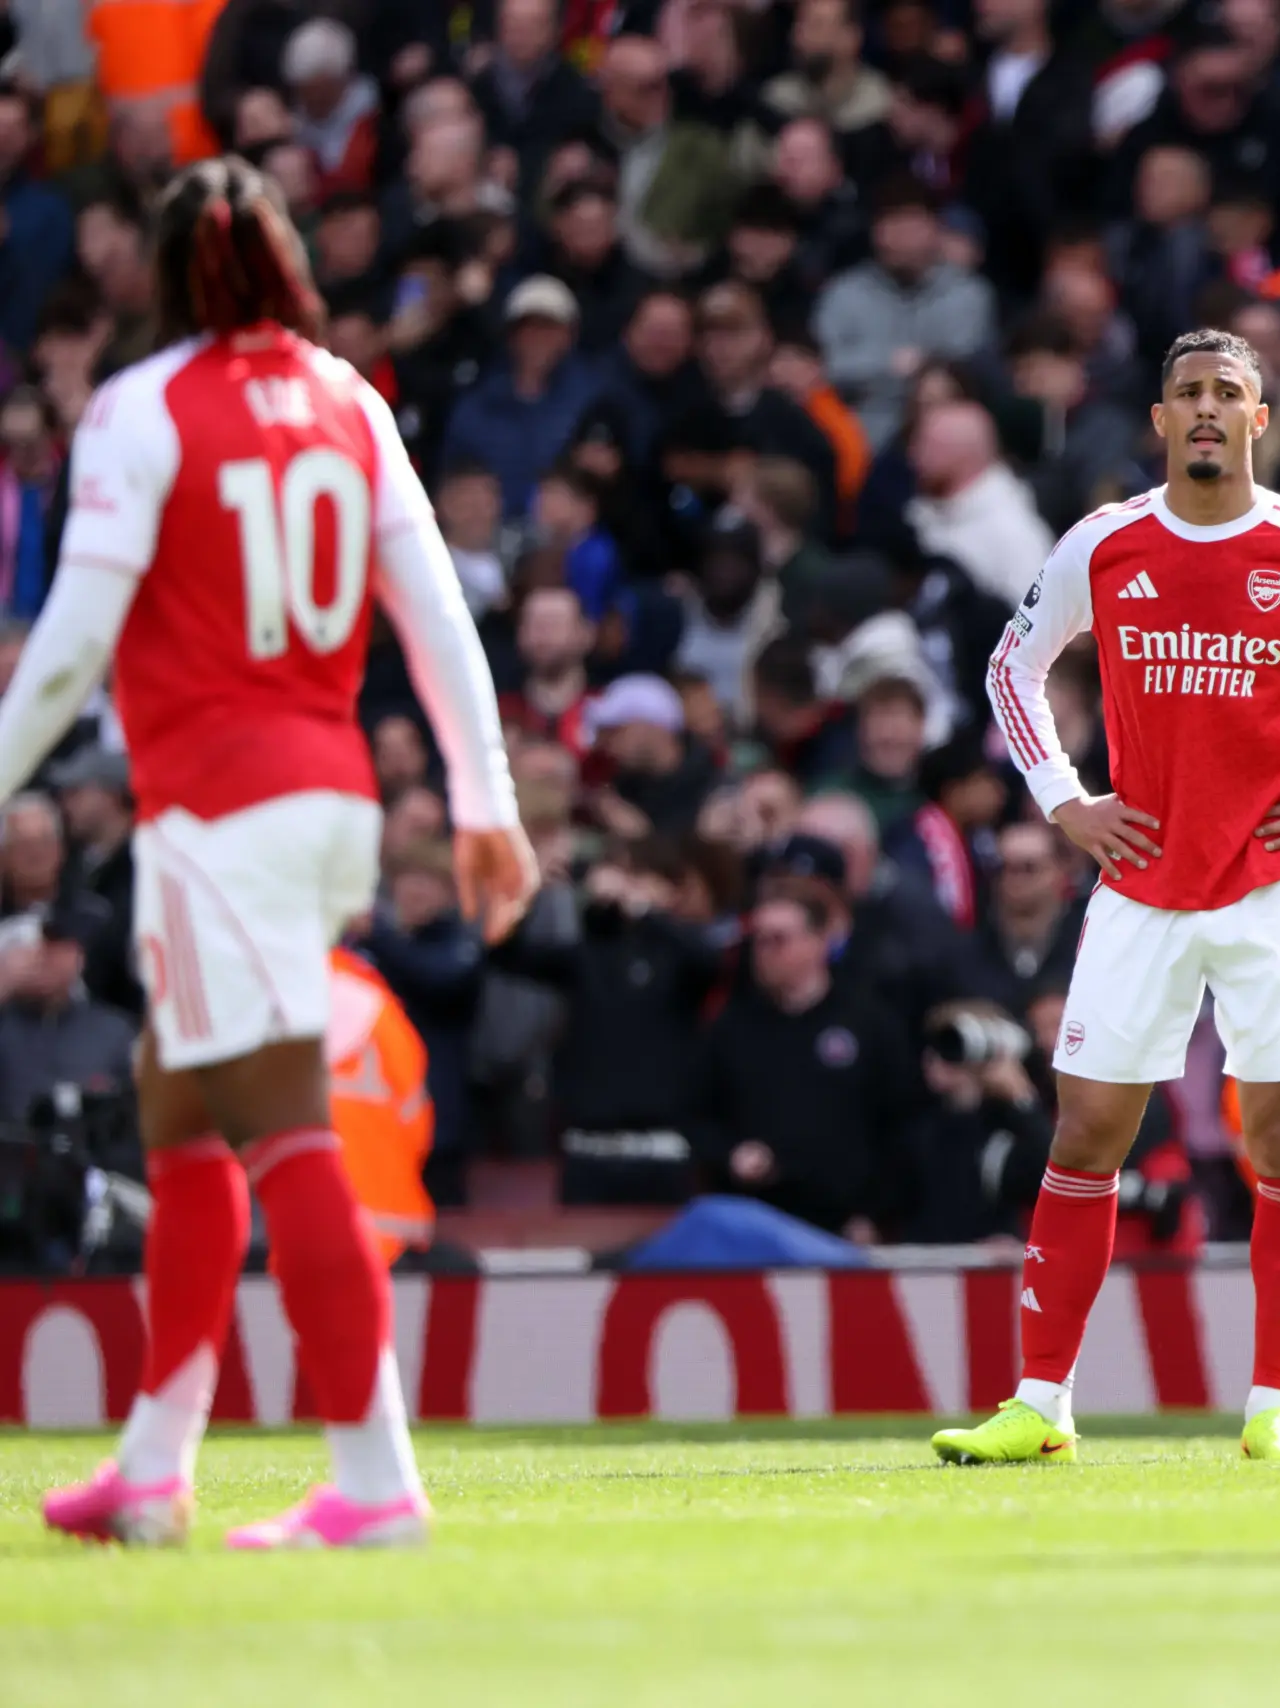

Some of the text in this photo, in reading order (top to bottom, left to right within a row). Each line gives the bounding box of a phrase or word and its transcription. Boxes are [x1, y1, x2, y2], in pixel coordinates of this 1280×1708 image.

[219, 446, 370, 661] 10
[1144, 665, 1256, 697] FLY BETTER
